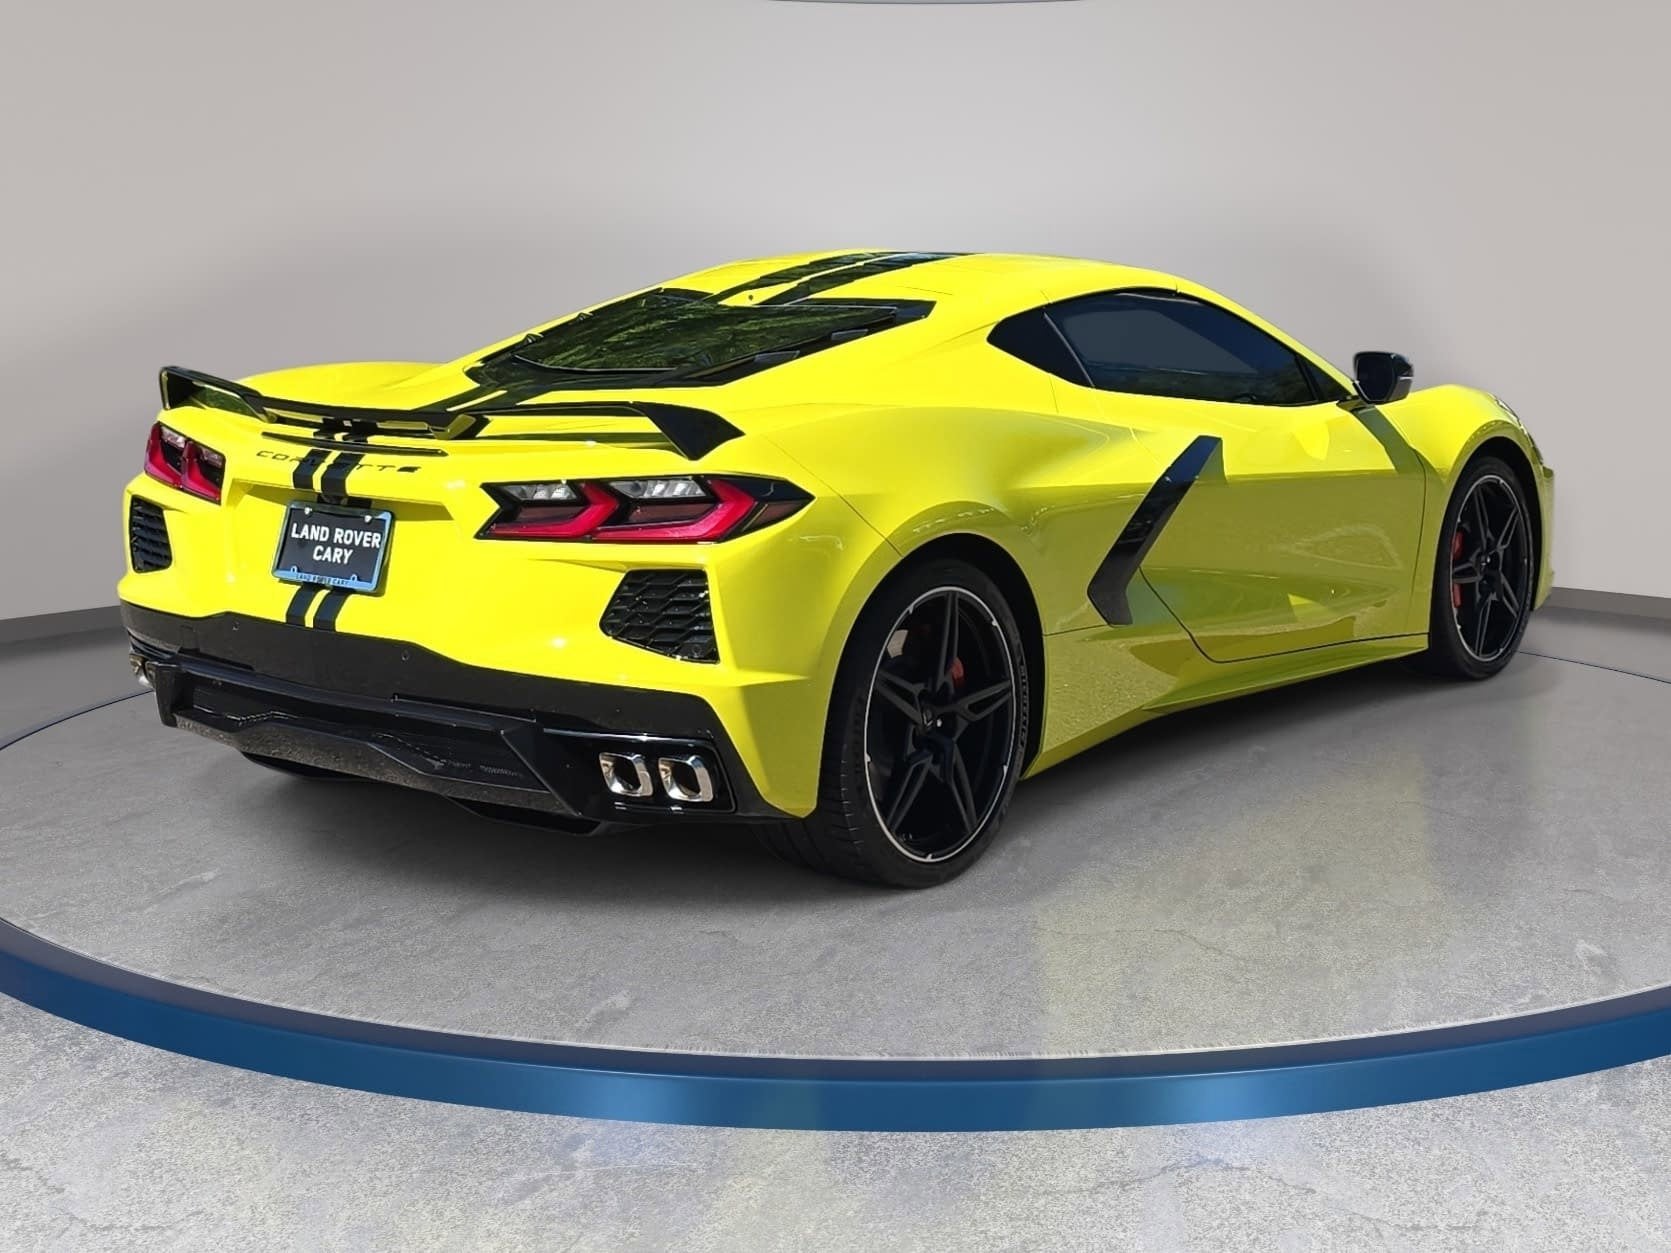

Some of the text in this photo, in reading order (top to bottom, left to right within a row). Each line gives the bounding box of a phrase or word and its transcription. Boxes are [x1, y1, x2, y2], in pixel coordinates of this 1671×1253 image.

[291, 522, 382, 549] LAND ROVER
[312, 544, 354, 565] CARY
